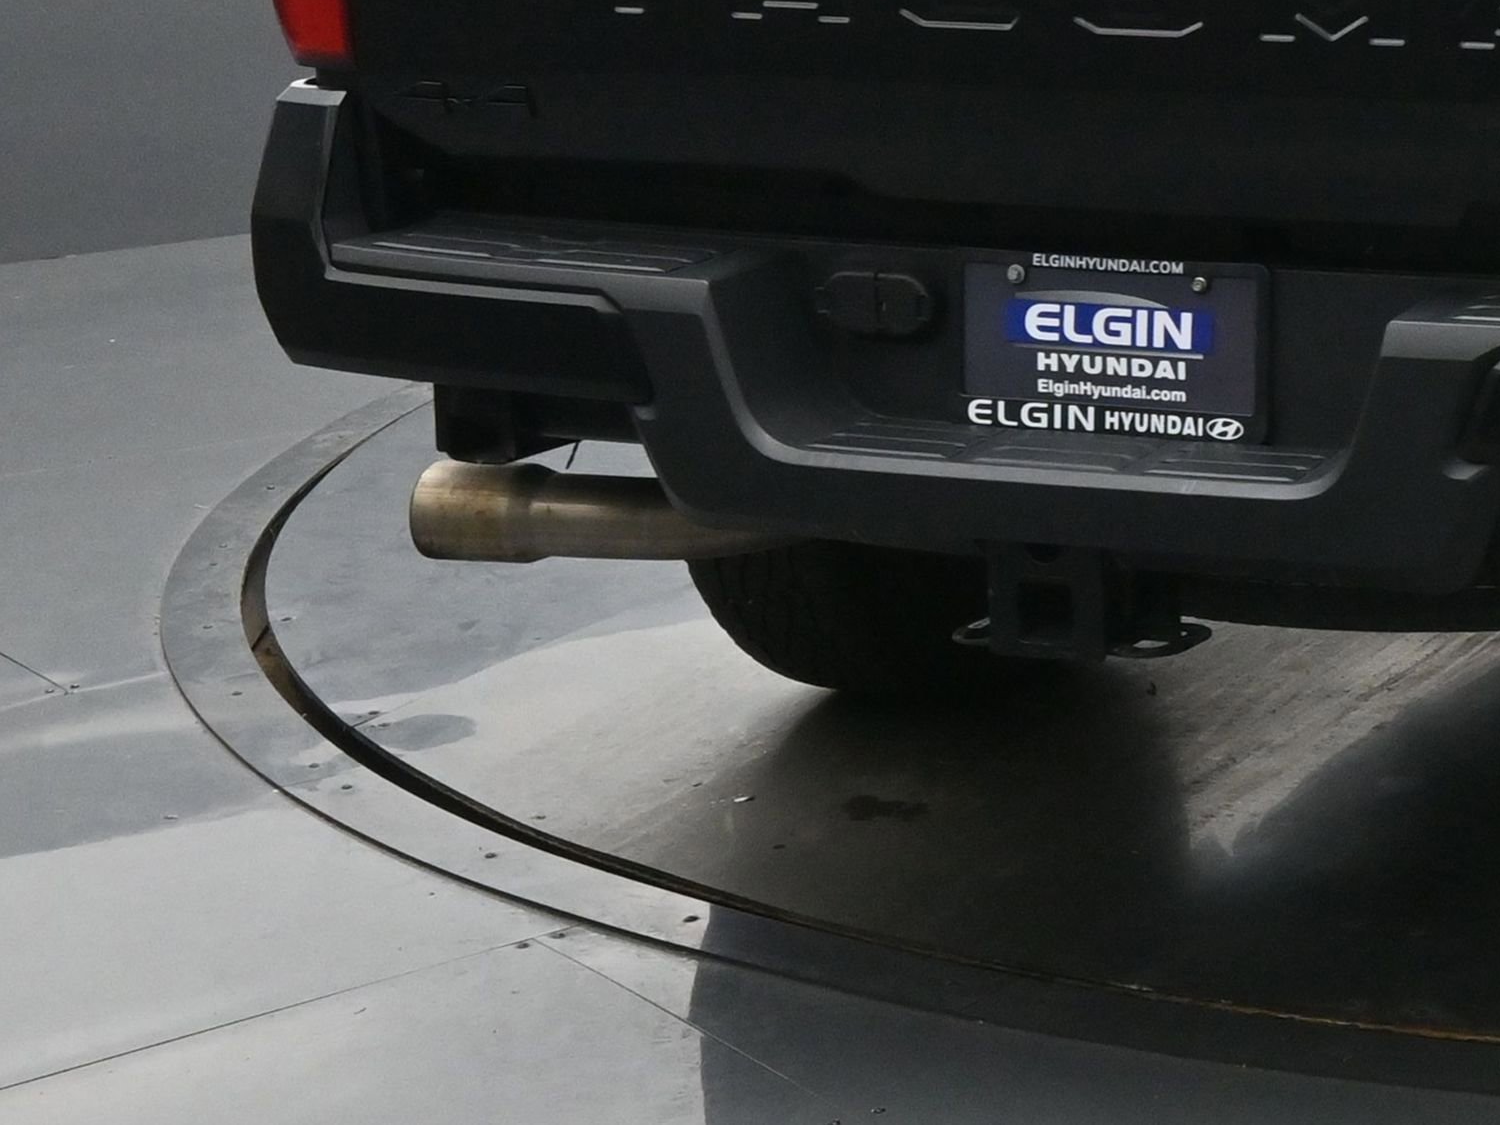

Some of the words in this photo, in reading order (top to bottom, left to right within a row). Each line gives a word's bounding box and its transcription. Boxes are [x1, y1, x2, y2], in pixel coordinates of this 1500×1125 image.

[1032, 253, 1184, 275] ELGINHYUNDAI.COM
[1024, 303, 1193, 350] ELGIN
[1036, 352, 1187, 381] HYUNDAI
[1037, 378, 1187, 403] ElginHyundai.com
[967, 398, 1095, 432] ELGIN
[1104, 410, 1204, 437] HYUNDAI
